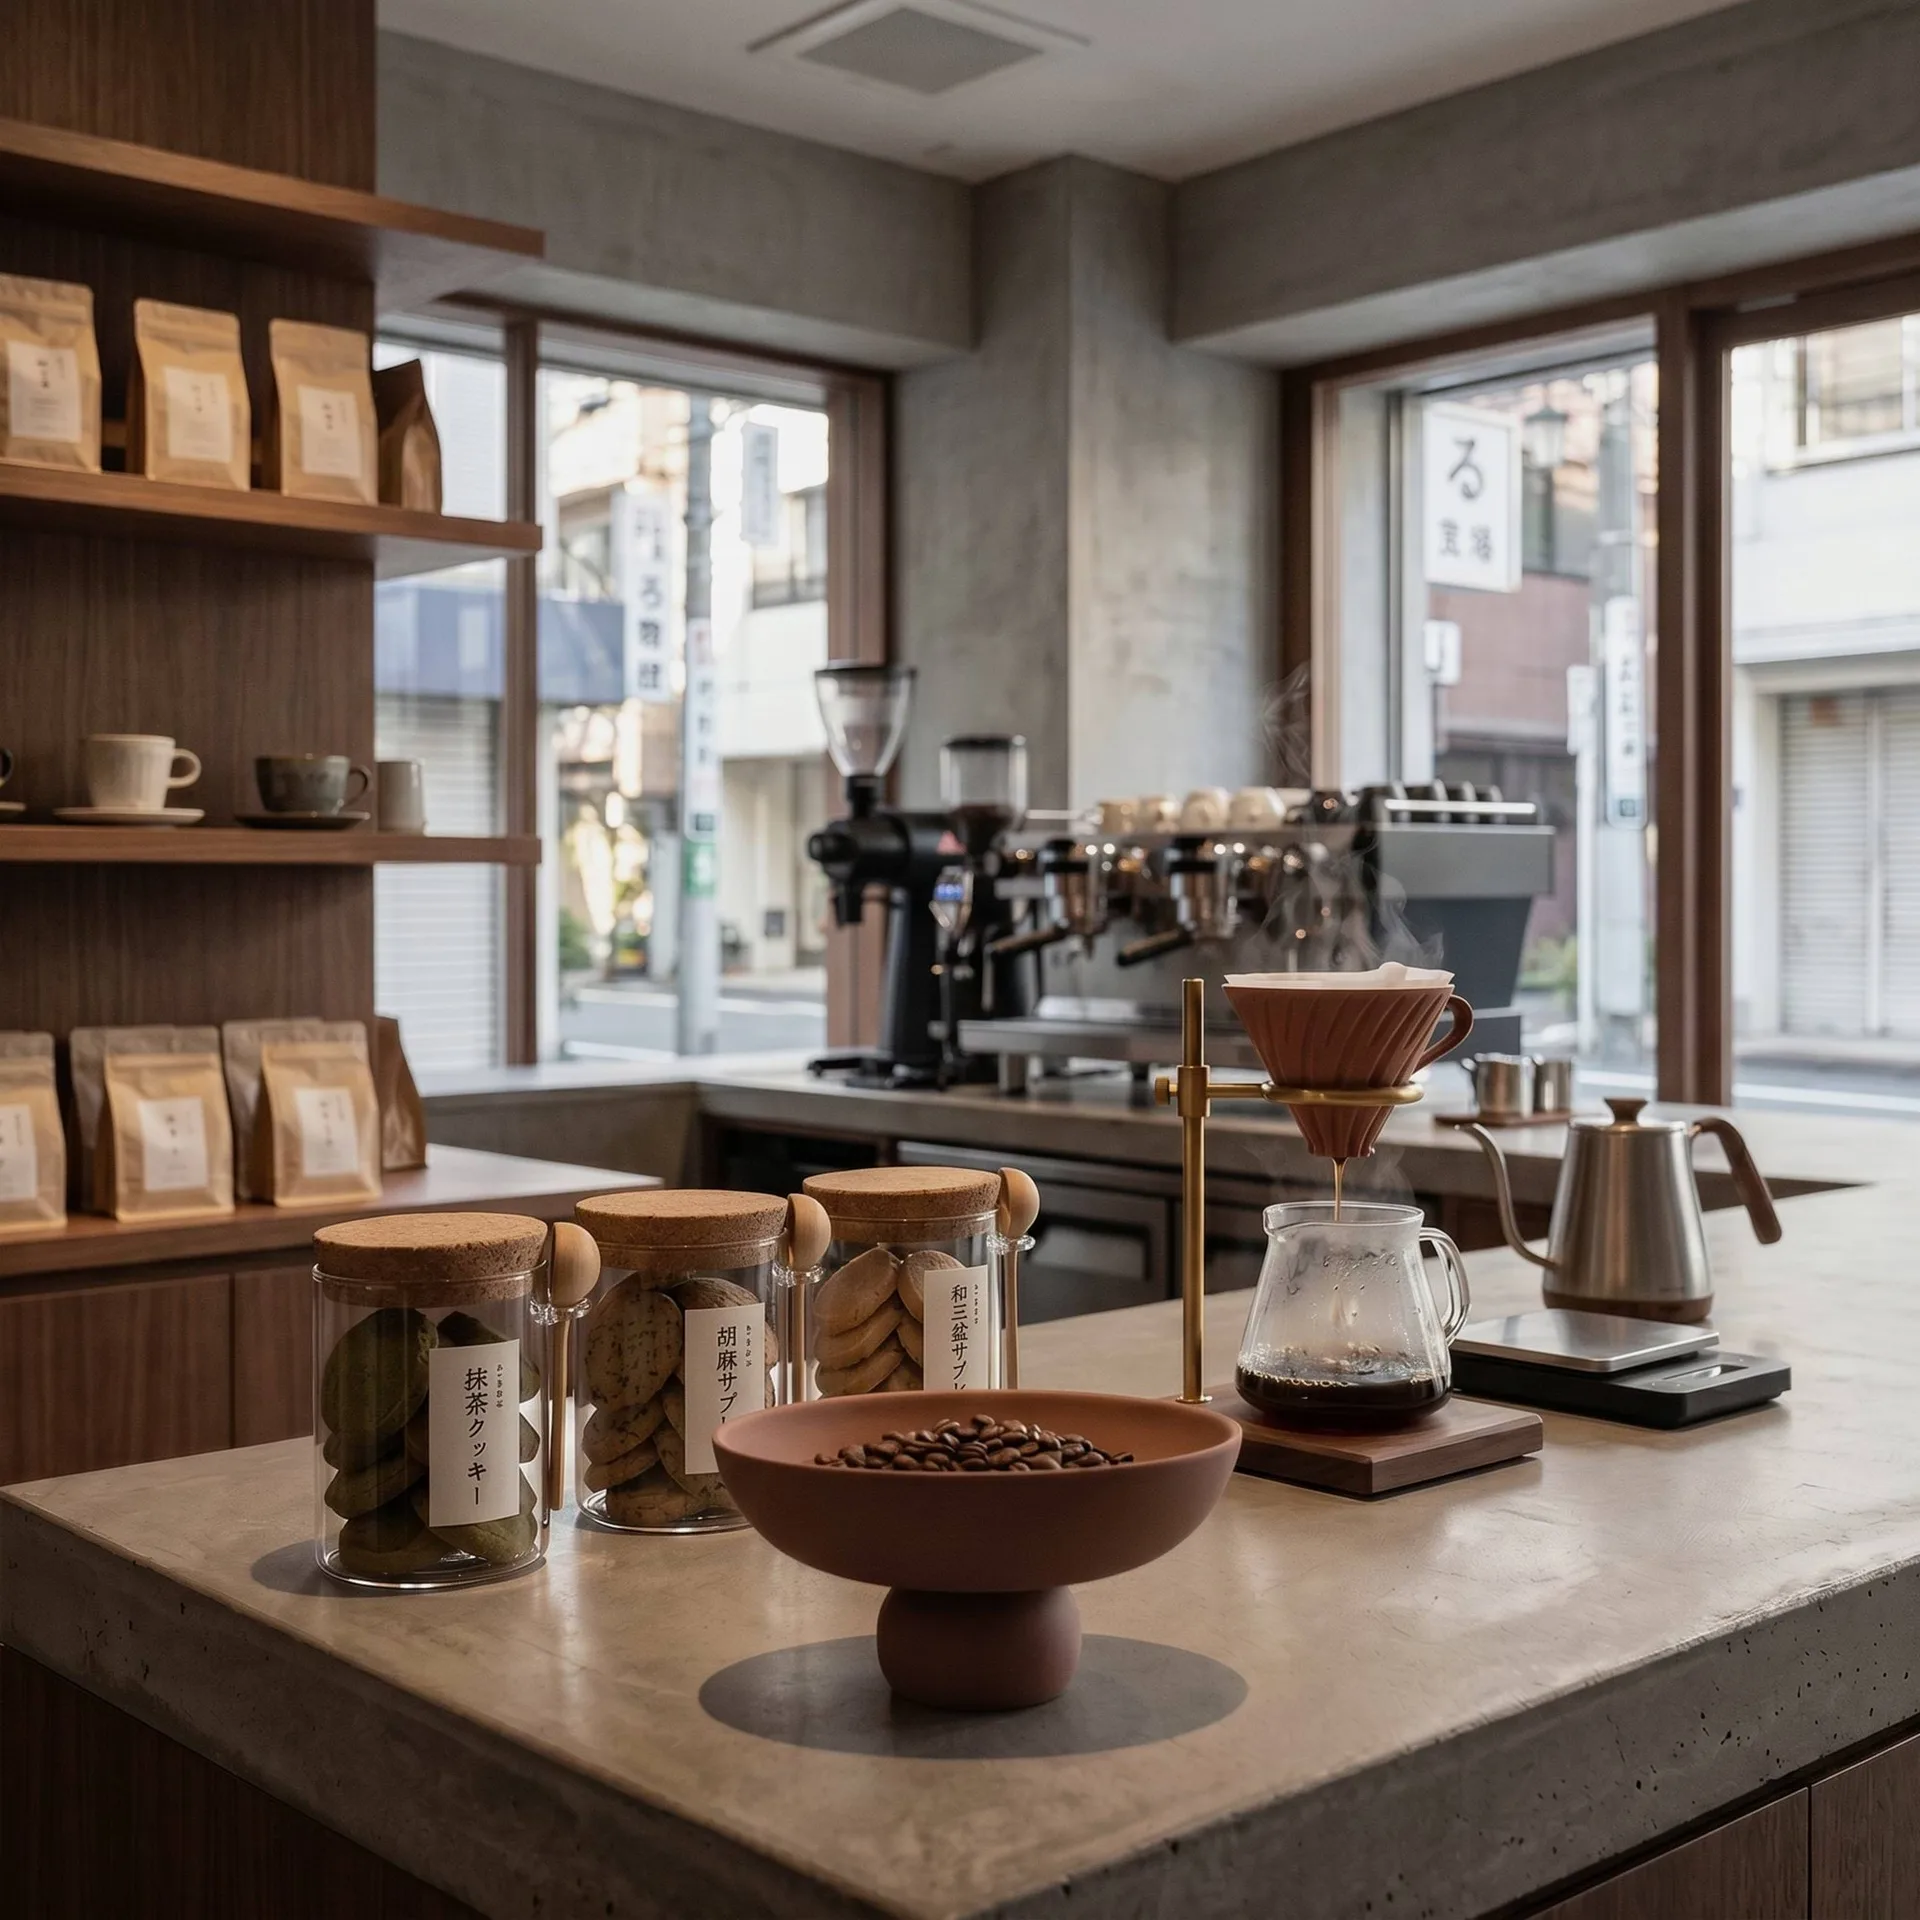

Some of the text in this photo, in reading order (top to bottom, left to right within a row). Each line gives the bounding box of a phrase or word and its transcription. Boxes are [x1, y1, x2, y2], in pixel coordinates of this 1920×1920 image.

[716, 1326, 738, 1425] 胡麻サプ
[463, 1367, 489, 1505] 抹茶クッキー
